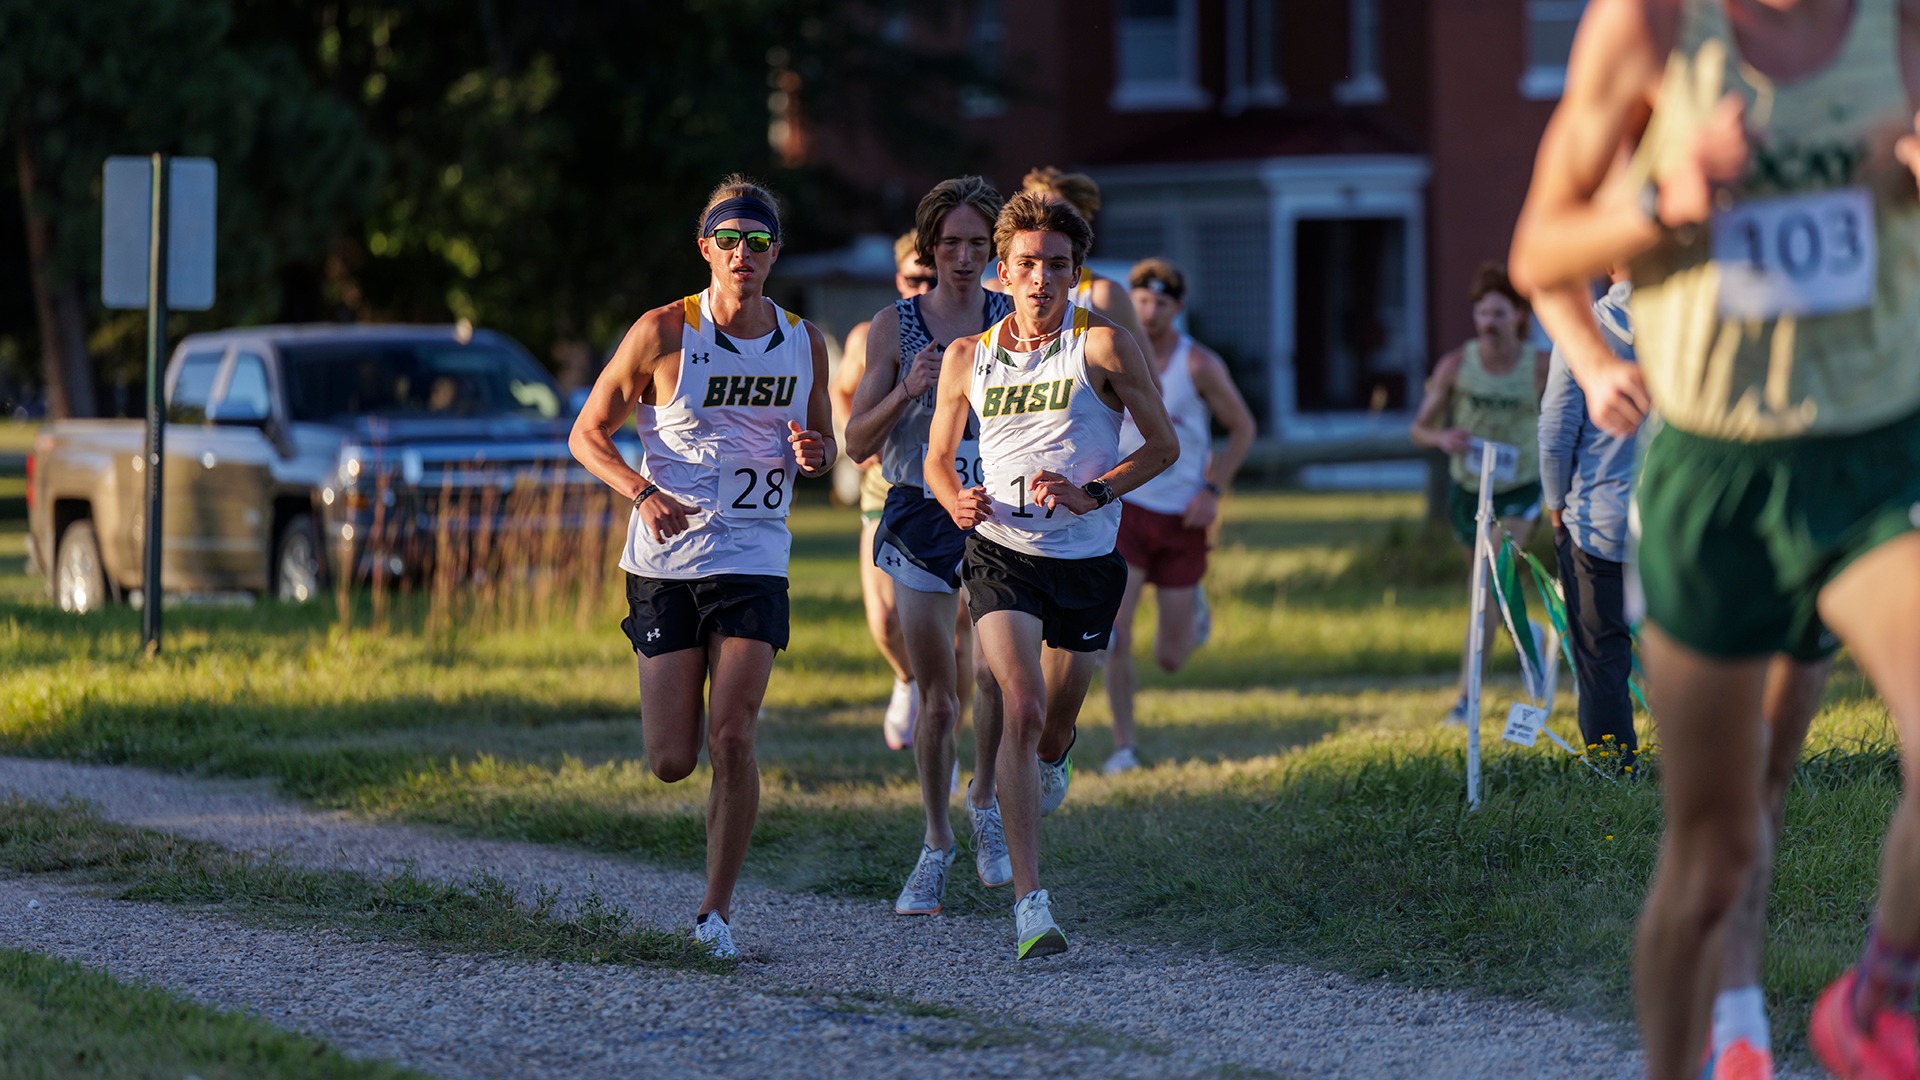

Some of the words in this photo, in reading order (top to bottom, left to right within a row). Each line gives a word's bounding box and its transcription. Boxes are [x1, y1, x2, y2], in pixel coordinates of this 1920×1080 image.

[1738, 204, 1864, 282] 103
[702, 375, 798, 408] BHSU
[982, 378, 1074, 418] BHSU
[731, 467, 786, 510] 28
